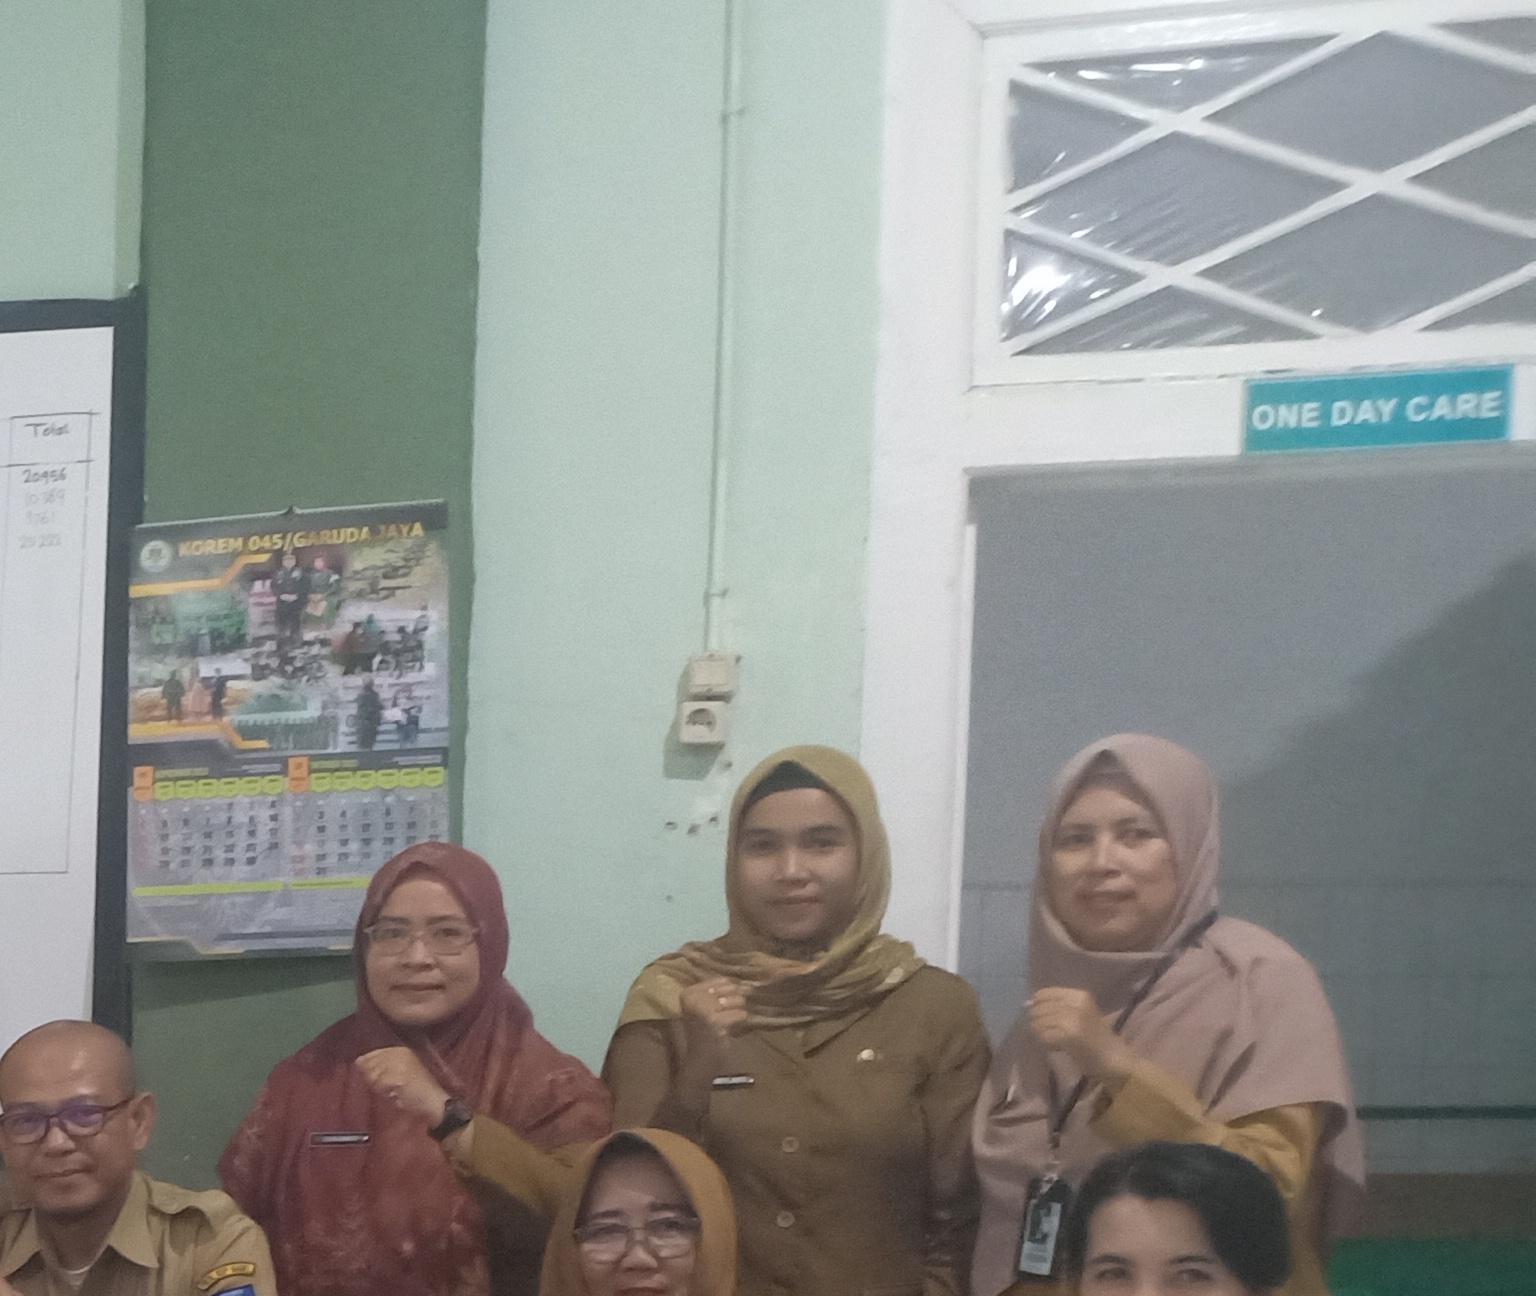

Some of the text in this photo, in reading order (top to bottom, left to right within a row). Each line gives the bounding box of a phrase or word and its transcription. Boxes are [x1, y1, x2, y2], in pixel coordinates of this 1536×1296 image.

[1252, 391, 1502, 430] ONE DAY CARE
[179, 521, 425, 557] KOREM 045/GARUDA JAYA
